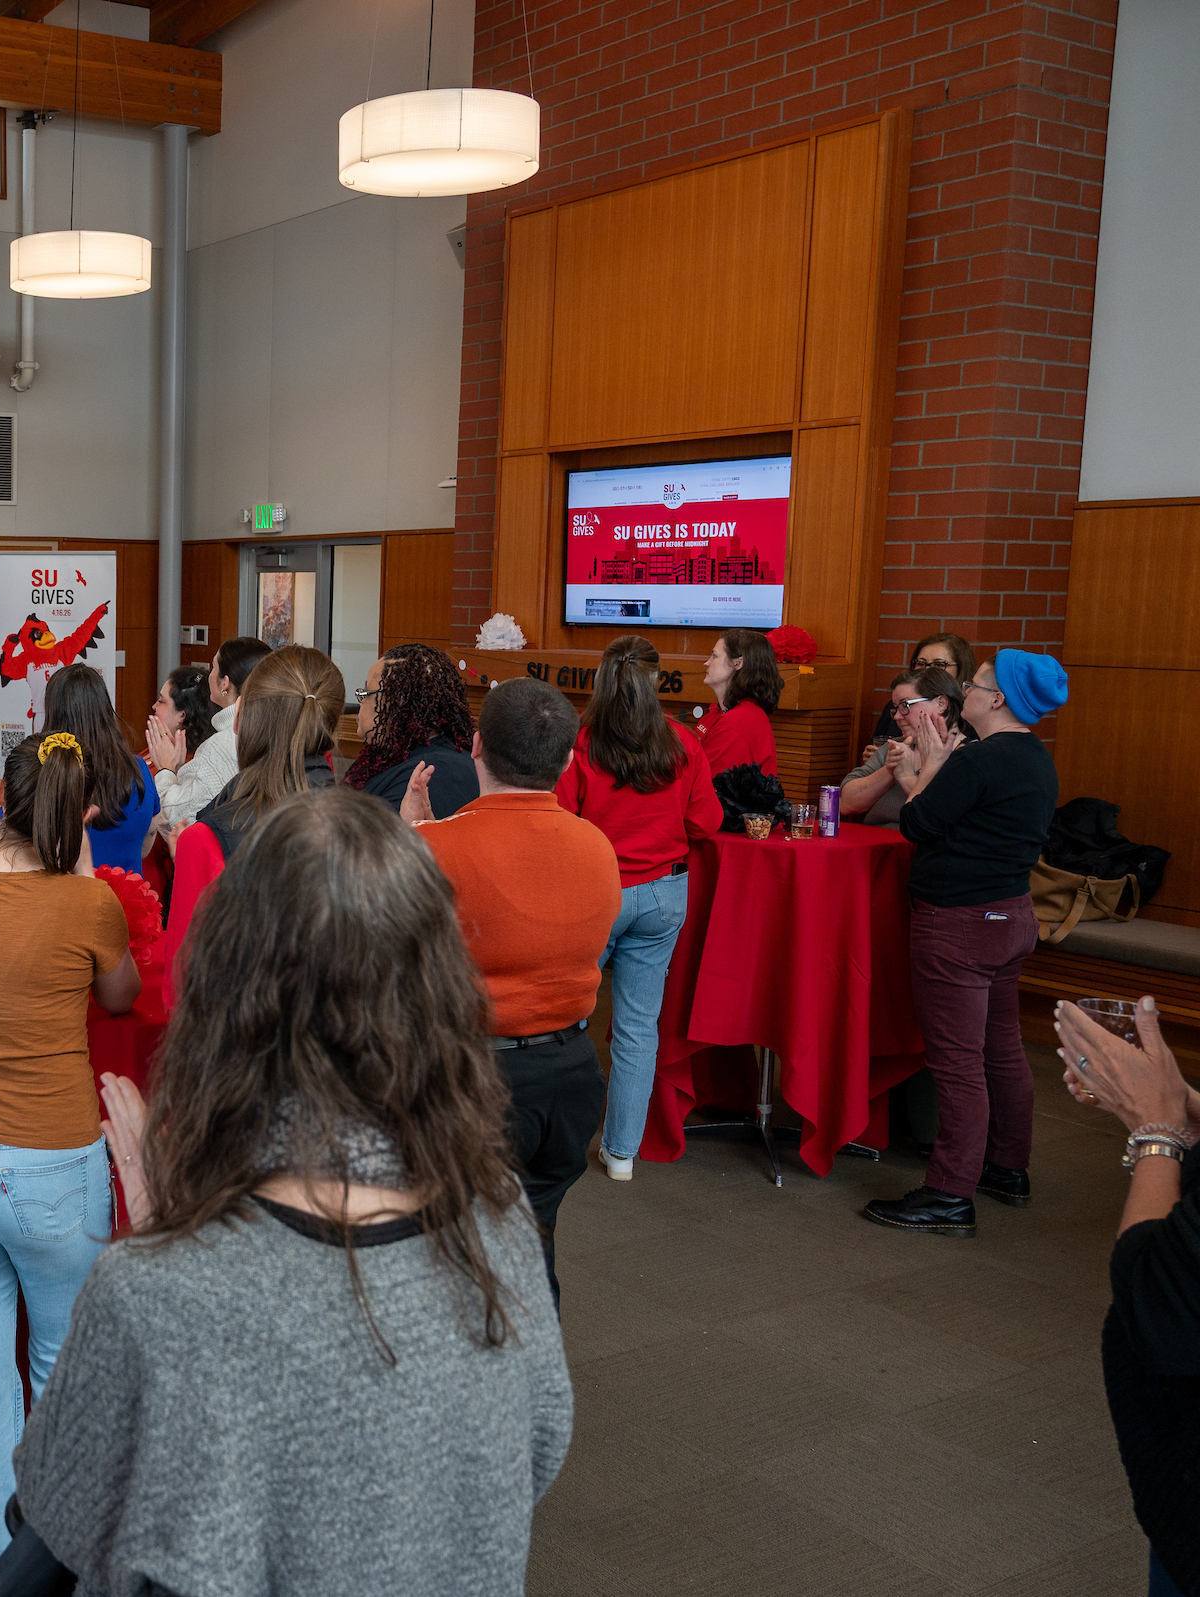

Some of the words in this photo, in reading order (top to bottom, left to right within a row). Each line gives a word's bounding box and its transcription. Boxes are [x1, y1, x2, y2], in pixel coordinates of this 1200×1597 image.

[663, 484, 675, 493] SU
[663, 492, 681, 501] GIVES
[256, 504, 274, 529] EXIT
[573, 514, 586, 526] SU
[573, 525, 594, 536] GIVES
[613, 525, 631, 540] SU
[634, 524, 671, 540] GIVES
[675, 523, 688, 539] IS
[692, 522, 737, 538] TODAY
[31, 569, 58, 587] SU
[31, 589, 74, 605] GIVES
[51, 609, 72, 617] 4.16.26
[526, 661, 549, 683] SU
[557, 666, 598, 690] GIV
